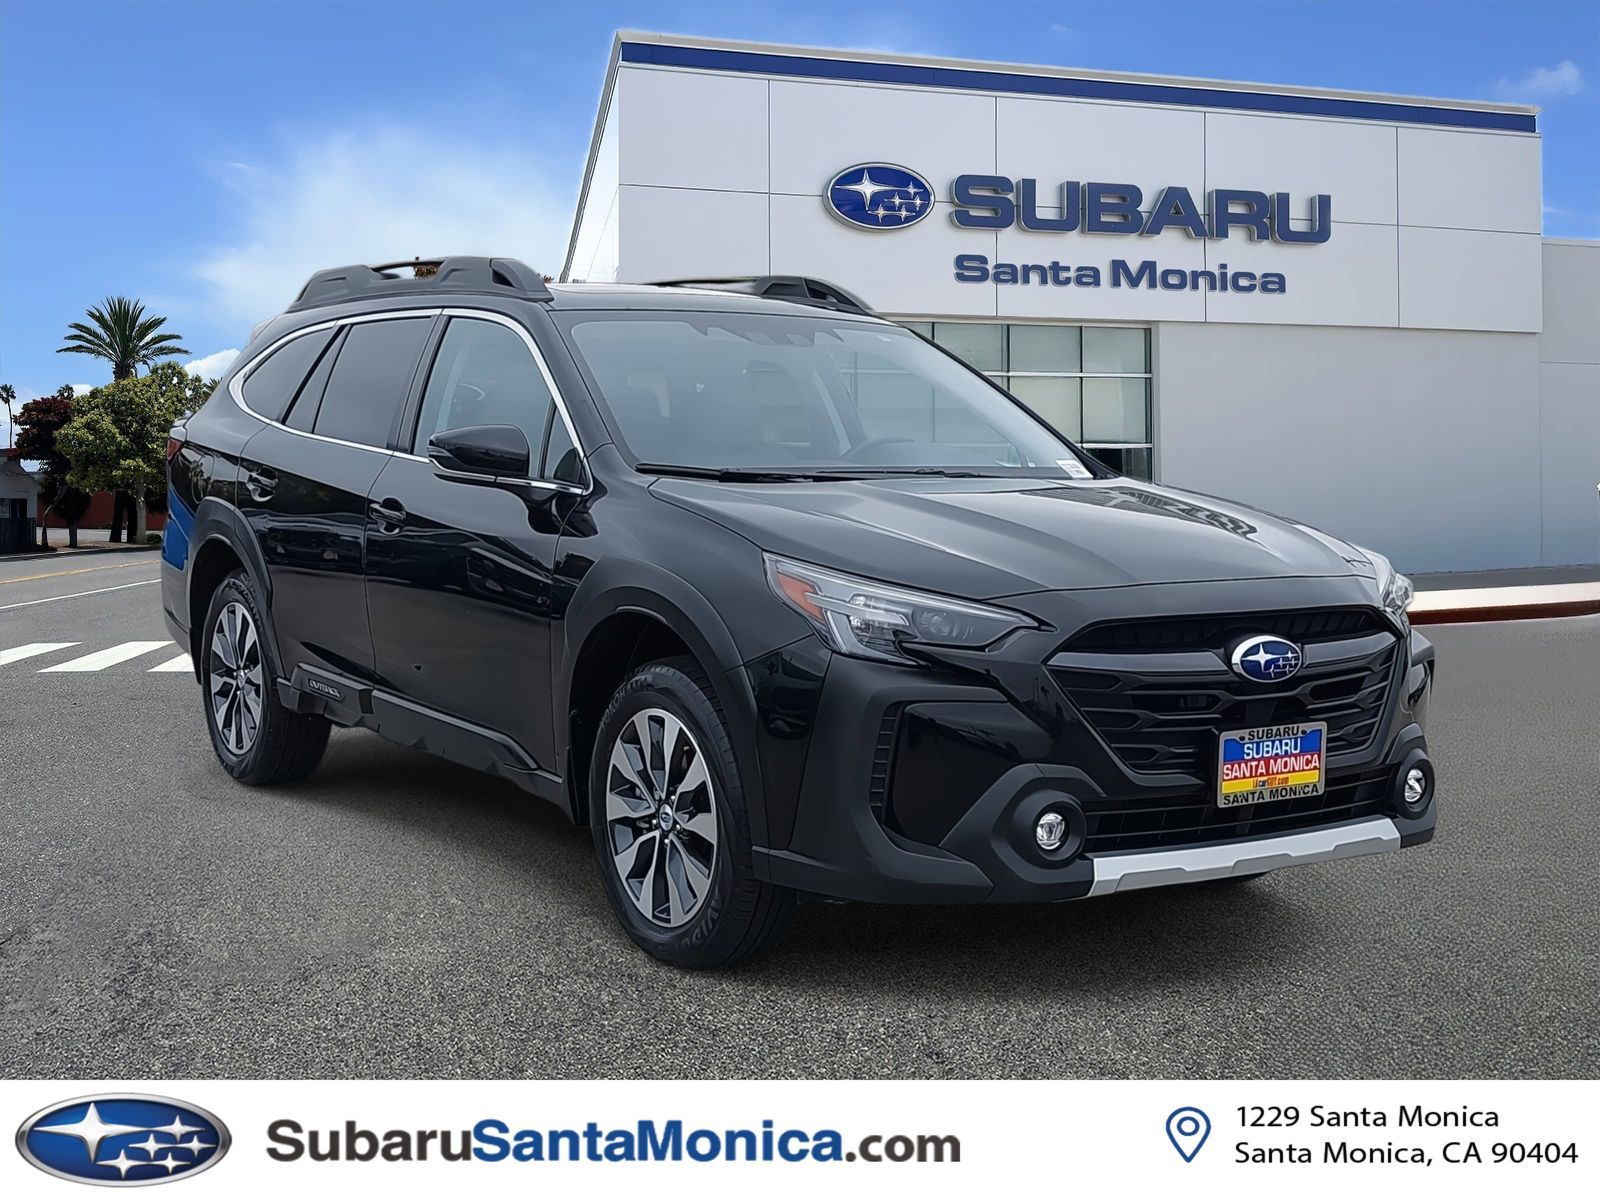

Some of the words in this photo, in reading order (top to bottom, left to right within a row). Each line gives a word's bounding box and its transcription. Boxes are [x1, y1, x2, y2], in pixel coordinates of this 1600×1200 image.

[950, 174, 1332, 244] SUBARU
[954, 253, 1101, 289] Santa
[1111, 259, 1287, 294] Monica
[1248, 725, 1300, 741] SUBARU
[1244, 738, 1301, 759] SUBARU
[1223, 760, 1266, 780] SANTA
[1269, 754, 1320, 774] MONICA
[1223, 791, 1266, 806] SANTA
[1269, 784, 1319, 800] MONICA
